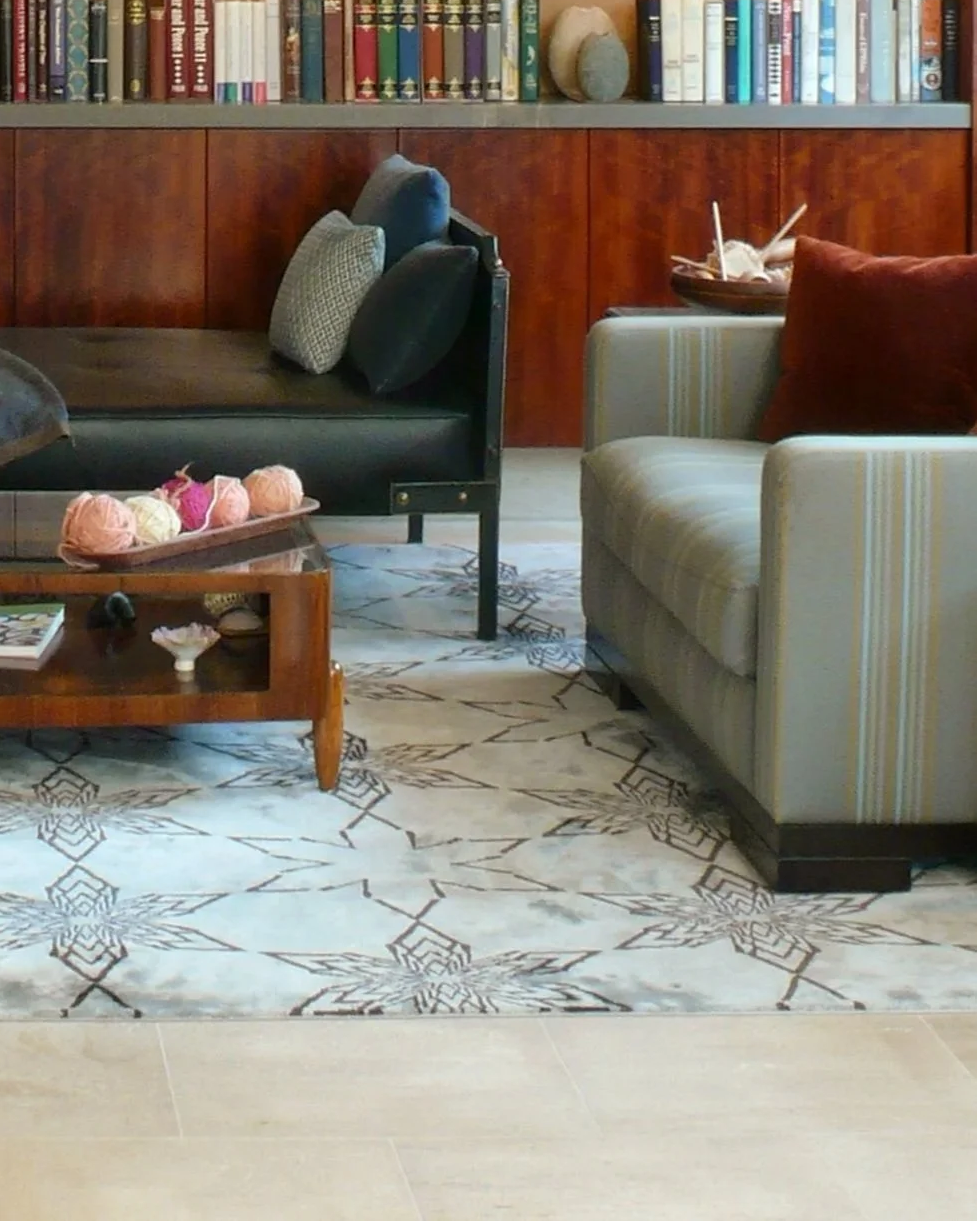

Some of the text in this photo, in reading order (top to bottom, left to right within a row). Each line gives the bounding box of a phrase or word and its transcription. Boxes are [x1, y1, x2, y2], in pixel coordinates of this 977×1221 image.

[171, 8, 186, 26] and
[194, 8, 210, 26] and
[171, 27, 186, 51] Peace
[194, 27, 210, 51] Peace
